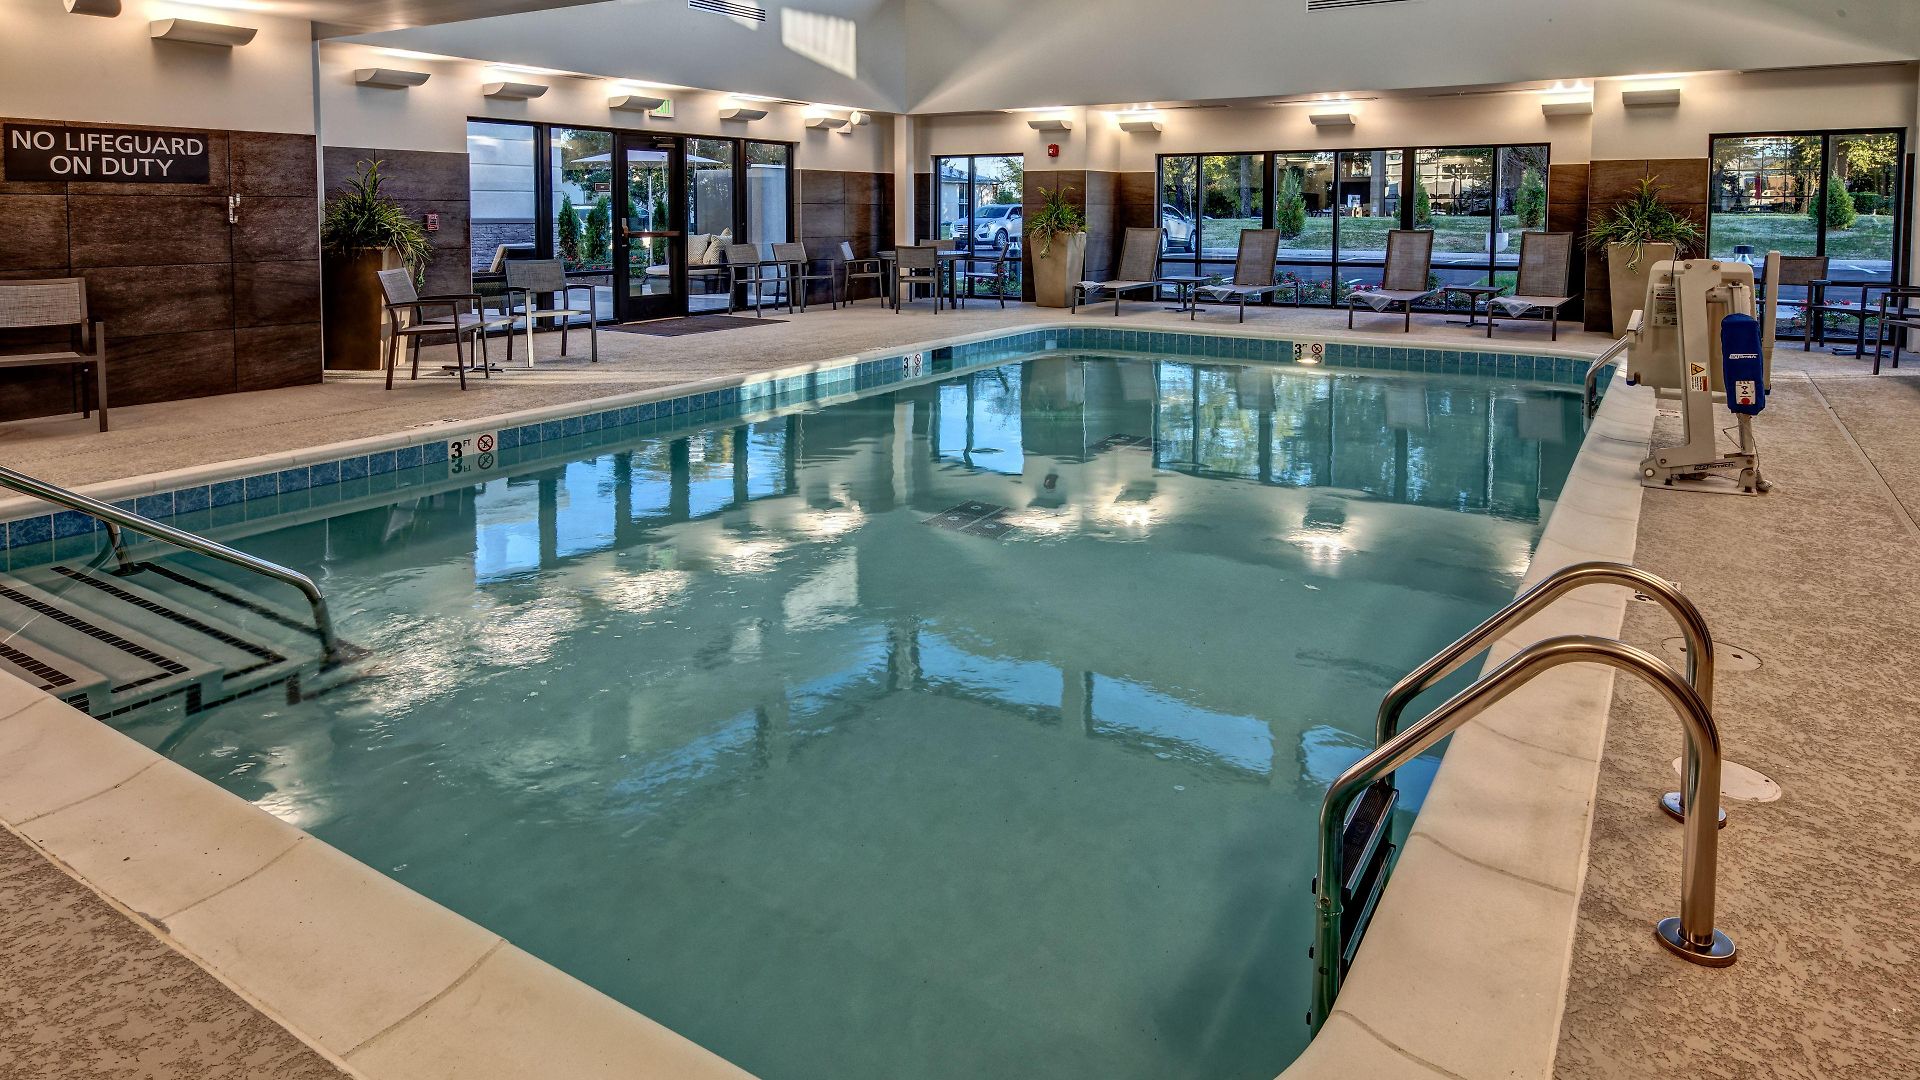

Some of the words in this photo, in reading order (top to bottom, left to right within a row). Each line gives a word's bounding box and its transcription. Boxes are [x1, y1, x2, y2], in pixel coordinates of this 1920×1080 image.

[12, 129, 55, 150] NO
[65, 132, 203, 156] LIFEGUARD
[50, 155, 91, 175] ON
[102, 157, 173, 176] DUTY
[1295, 343, 1302, 355] 3
[903, 356, 909, 368] 3
[451, 441, 463, 459] 3
[463, 438, 471, 447] FT
